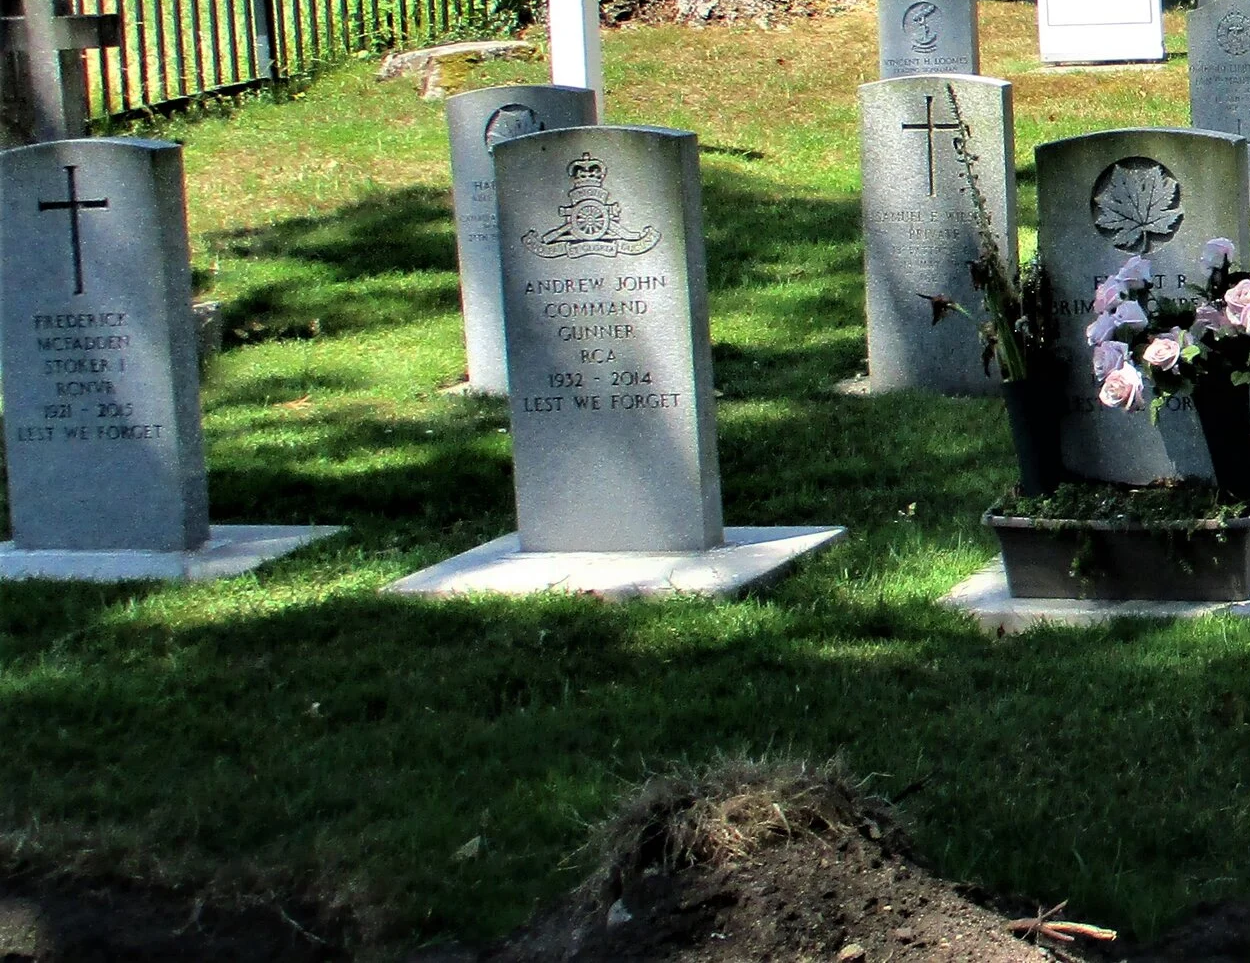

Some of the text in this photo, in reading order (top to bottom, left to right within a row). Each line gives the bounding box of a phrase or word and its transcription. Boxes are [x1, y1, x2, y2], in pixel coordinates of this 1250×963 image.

[884, 58, 920, 67] VINCENT
[525, 276, 666, 295] ANDREW JOHN
[545, 300, 648, 318] COMMAND
[33, 312, 130, 329] FREDERICK
[558, 325, 636, 342] GUNNER
[581, 349, 617, 364] RCA
[45, 358, 108, 374] STOKER
[549, 372, 584, 388] 1932
[611, 372, 652, 386] 2014
[523, 394, 680, 412] LEST WE FORGET
[18, 424, 162, 442] LEST WE FORGET
